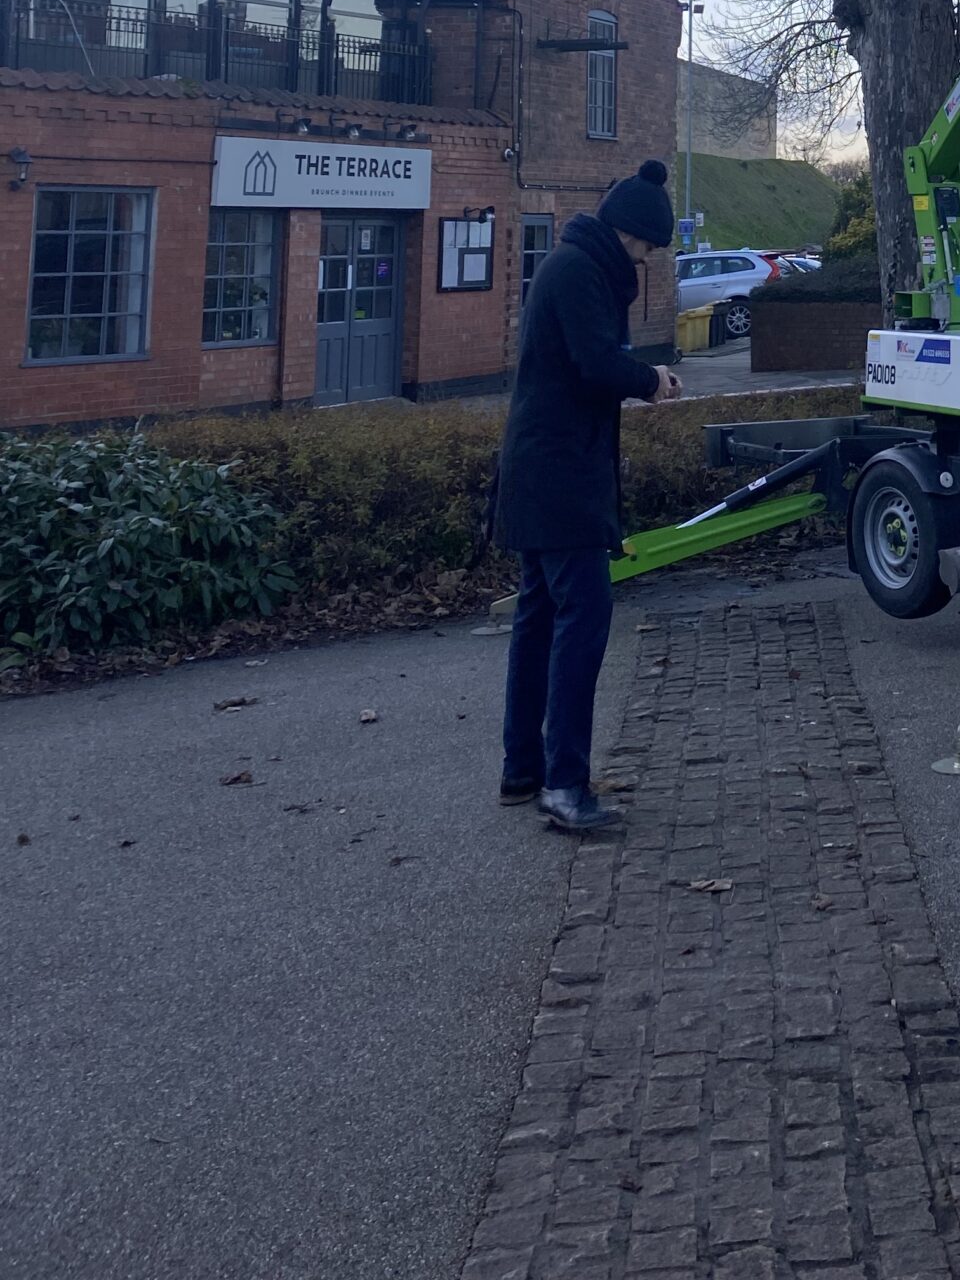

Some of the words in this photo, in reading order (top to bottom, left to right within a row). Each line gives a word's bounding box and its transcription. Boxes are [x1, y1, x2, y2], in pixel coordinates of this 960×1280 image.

[295, 154, 330, 176] THE
[336, 156, 412, 179] TERRACE
[311, 188, 340, 196] BRUNCH
